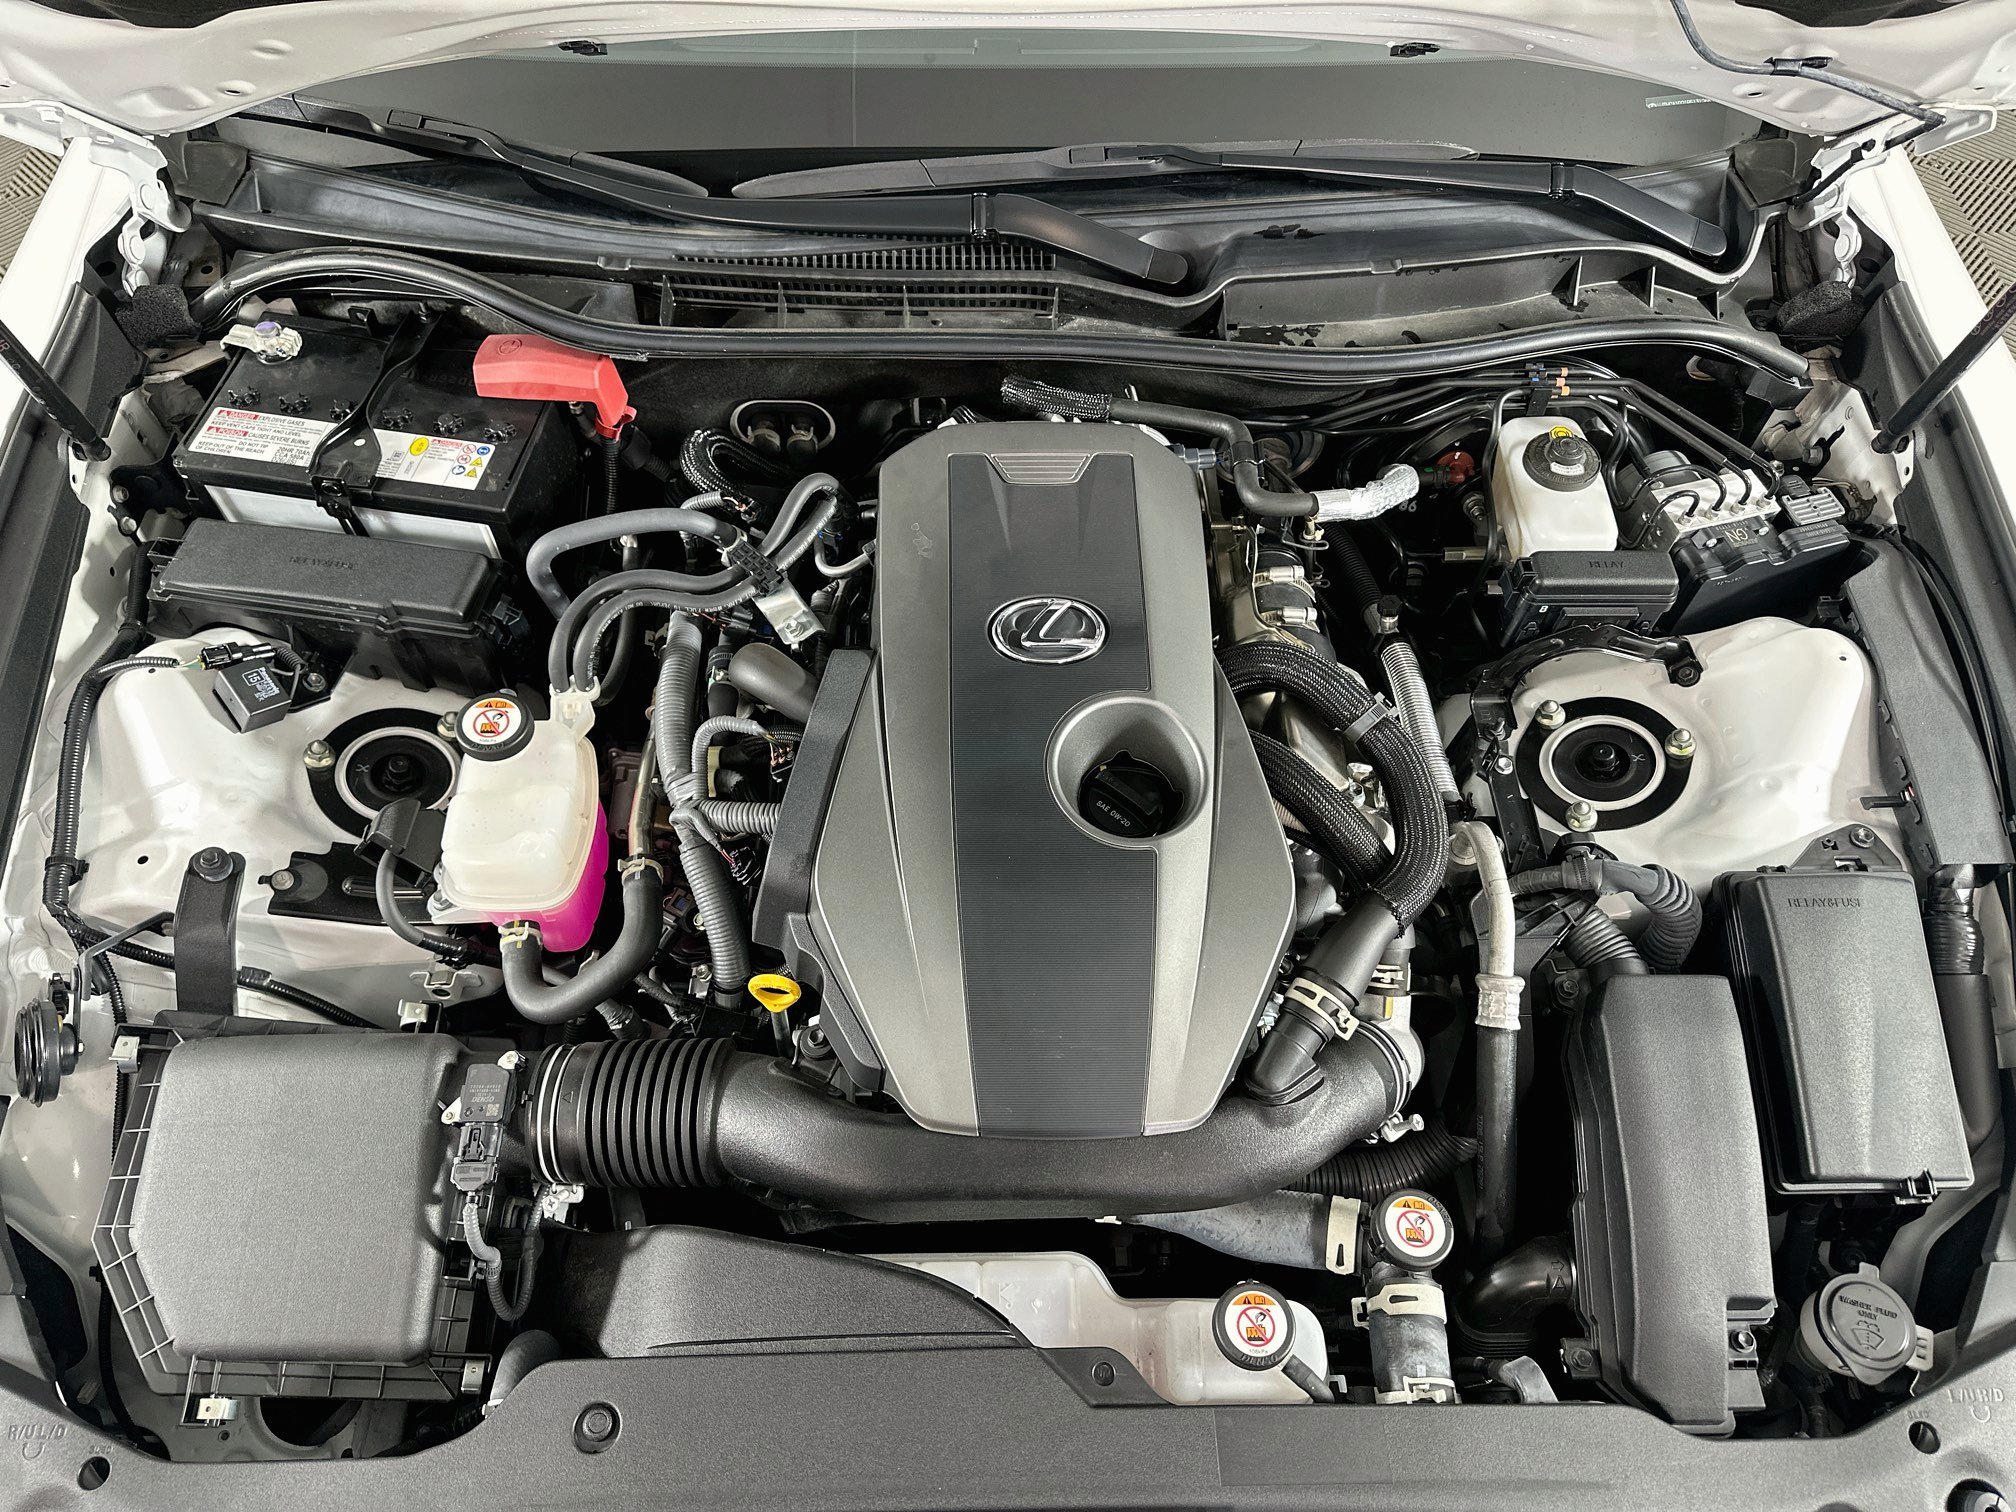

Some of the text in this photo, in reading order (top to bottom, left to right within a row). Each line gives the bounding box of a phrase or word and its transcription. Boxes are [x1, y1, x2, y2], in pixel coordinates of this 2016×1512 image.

[229, 411, 256, 420] DANGER
[259, 415, 286, 424] EXPLOSIVE
[287, 418, 305, 426] GASES
[220, 428, 244, 436] POISON
[248, 432, 269, 440] CAUSES
[270, 435, 290, 444] SEVERE
[290, 438, 310, 446] BURNS
[248, 672, 261, 682] 15
[1096, 800, 1131, 827] SAE 0W-20
[1787, 898, 1862, 908] RELAY&FUSE
[1838, 1295, 1898, 1319] WASHER FLUID
[1858, 1310, 1879, 1320] ONLY
